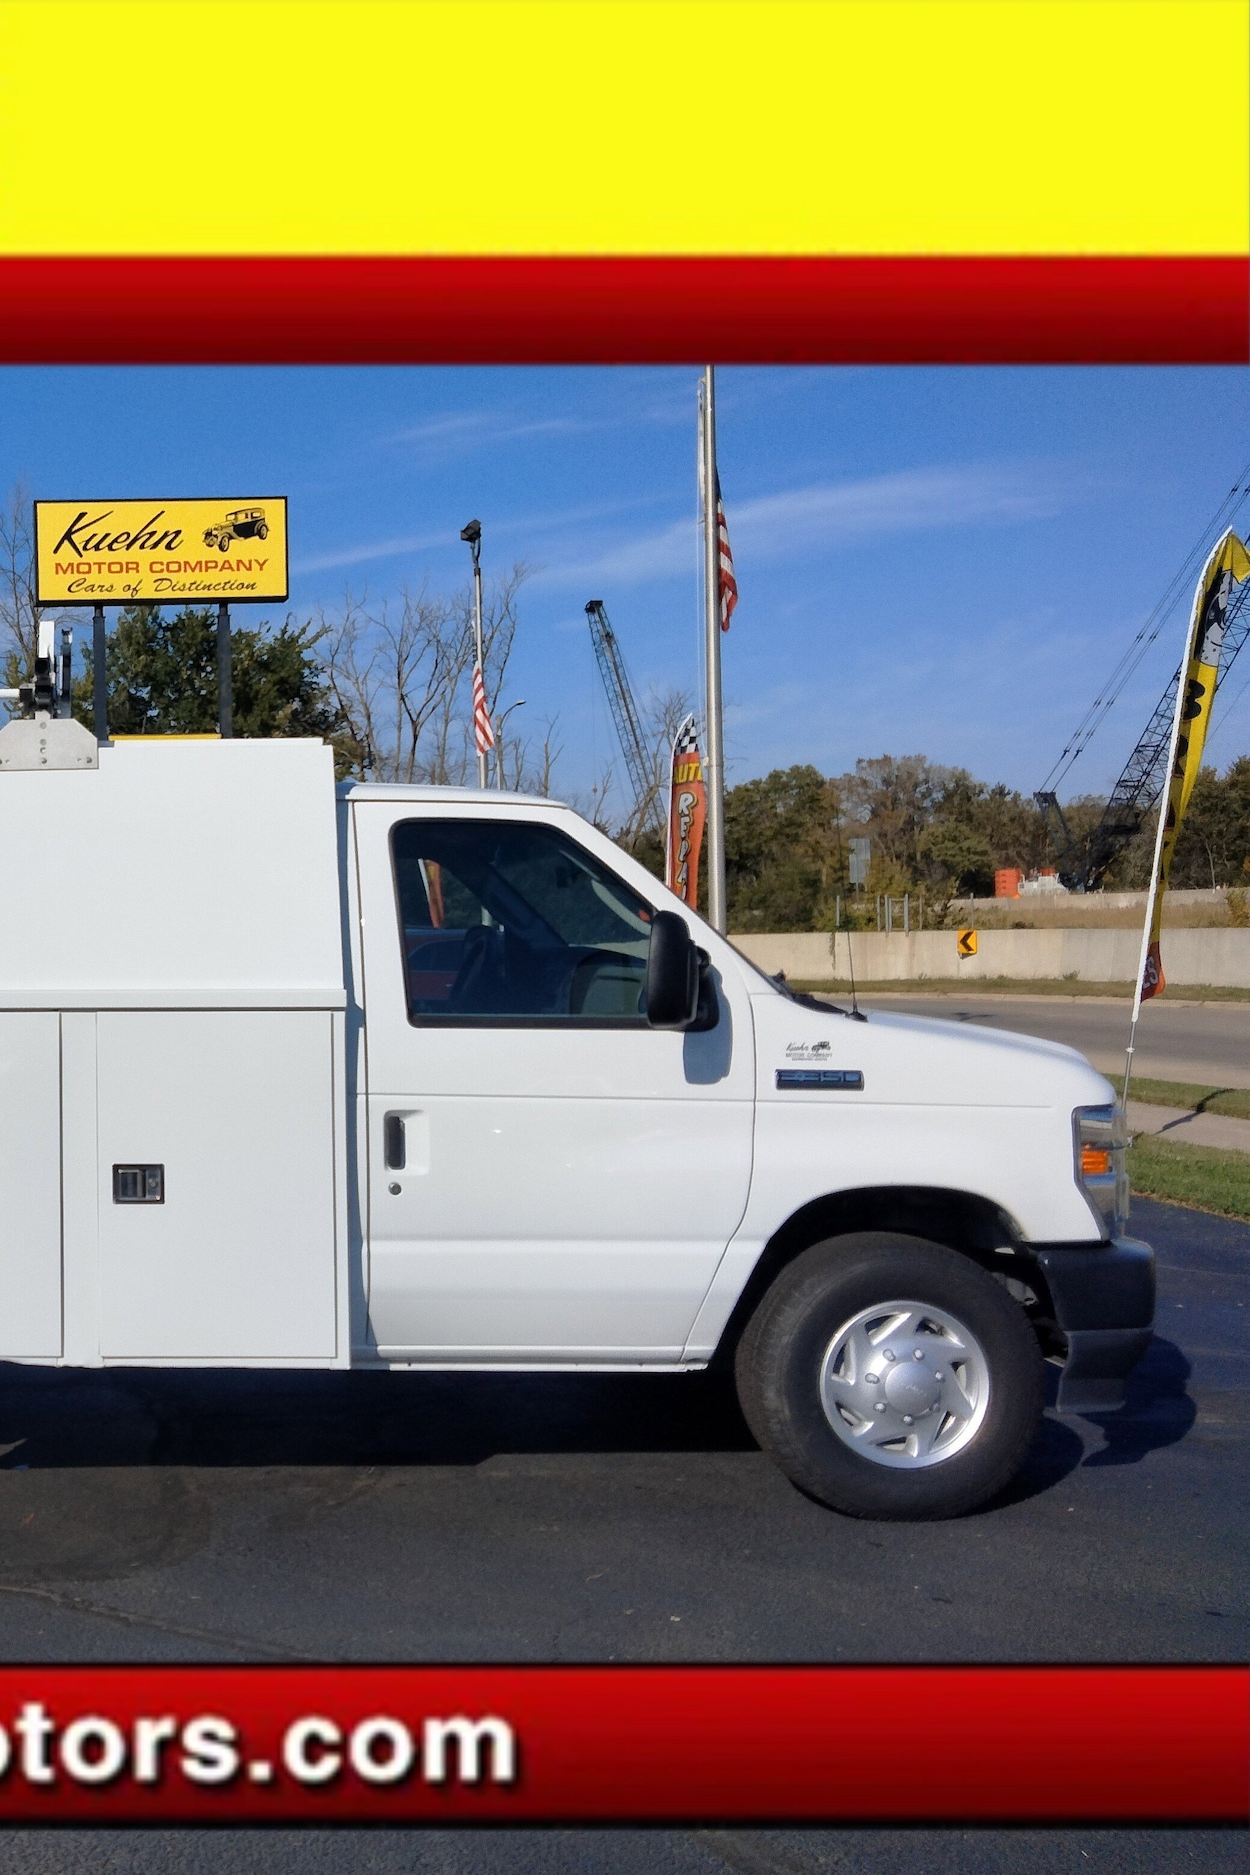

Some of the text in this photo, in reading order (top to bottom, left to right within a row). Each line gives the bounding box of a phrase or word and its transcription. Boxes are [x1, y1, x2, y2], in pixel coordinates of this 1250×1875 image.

[53, 510, 184, 558] Kuehn
[55, 558, 269, 575] MOTOR COMPANY
[67, 577, 258, 597] Cars of Distinction
